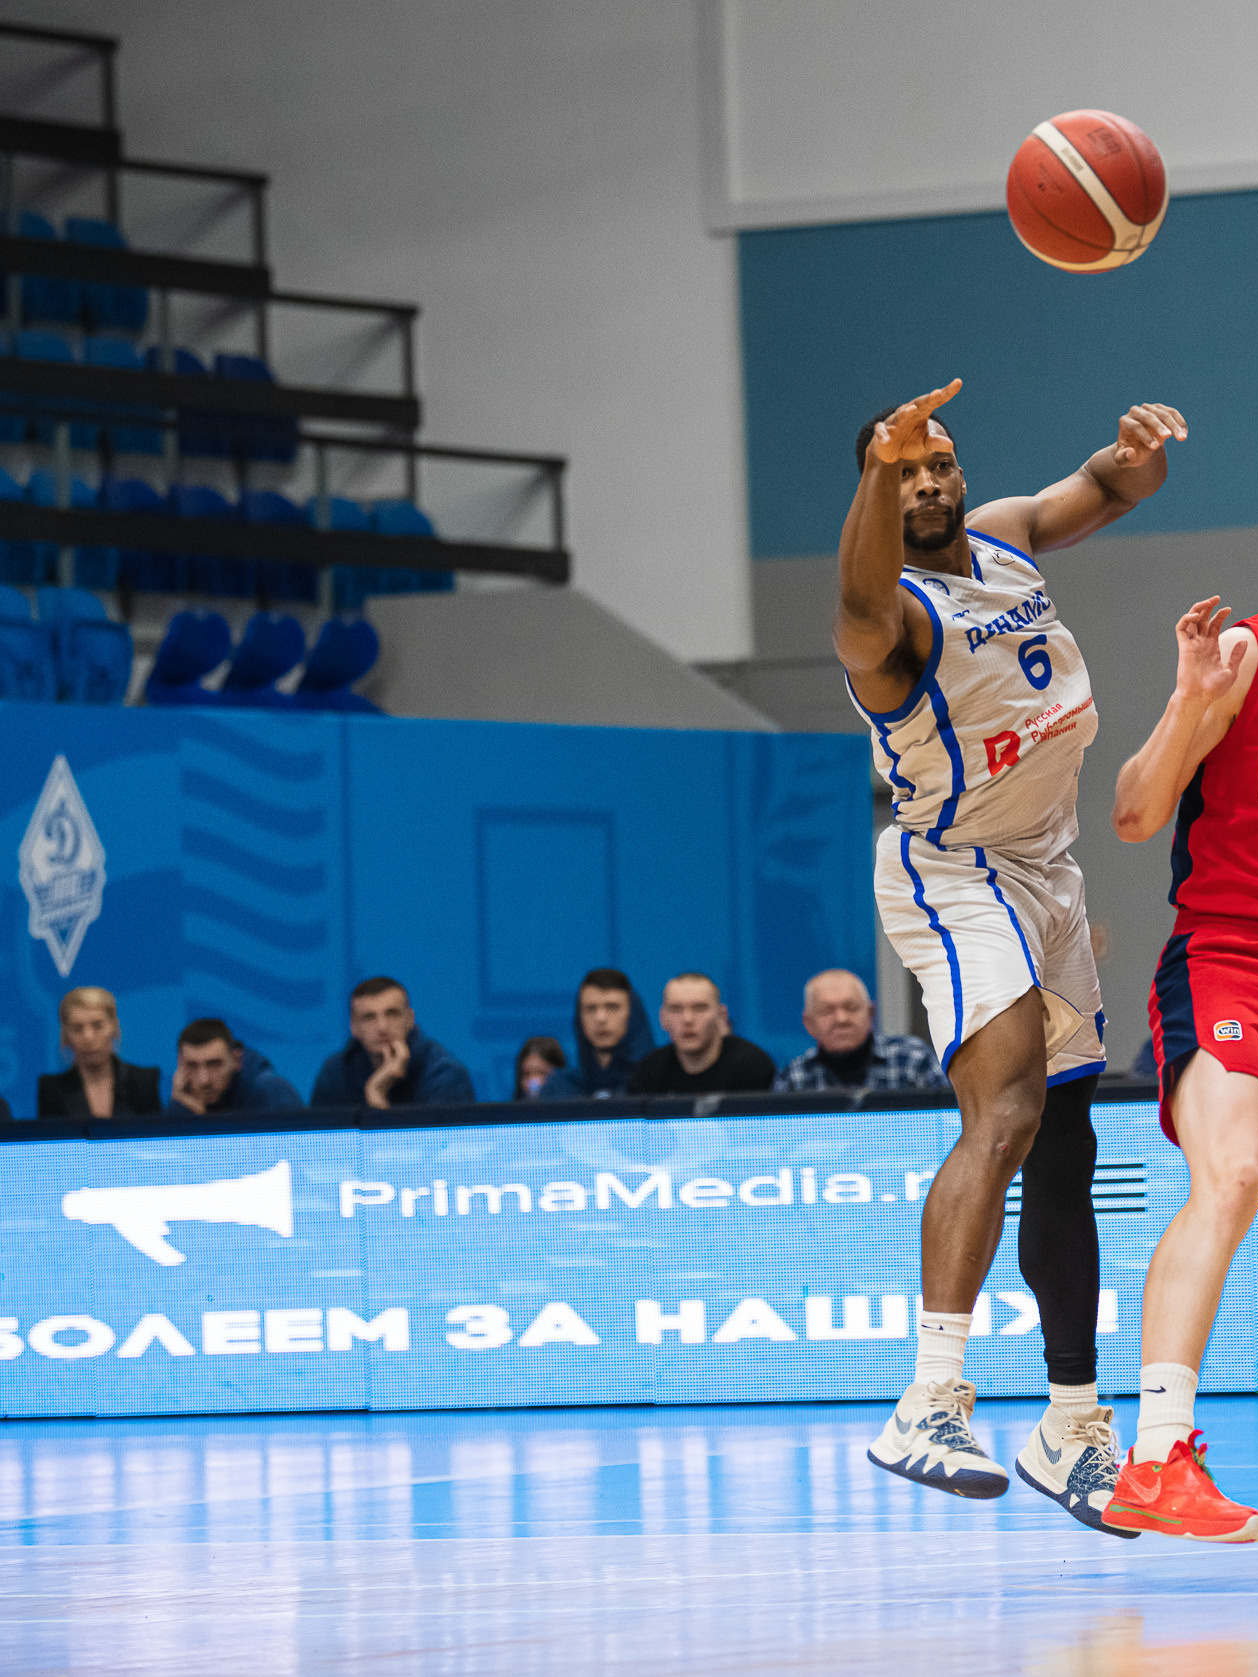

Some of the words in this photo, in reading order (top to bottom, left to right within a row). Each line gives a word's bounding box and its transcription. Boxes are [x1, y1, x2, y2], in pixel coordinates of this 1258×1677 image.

[1018, 634, 1052, 690] 6
[1025, 703, 1063, 729] Русская
[340, 1166, 936, 1218] PrimaMedia.r
[445, 1302, 602, 1349] ЗА
